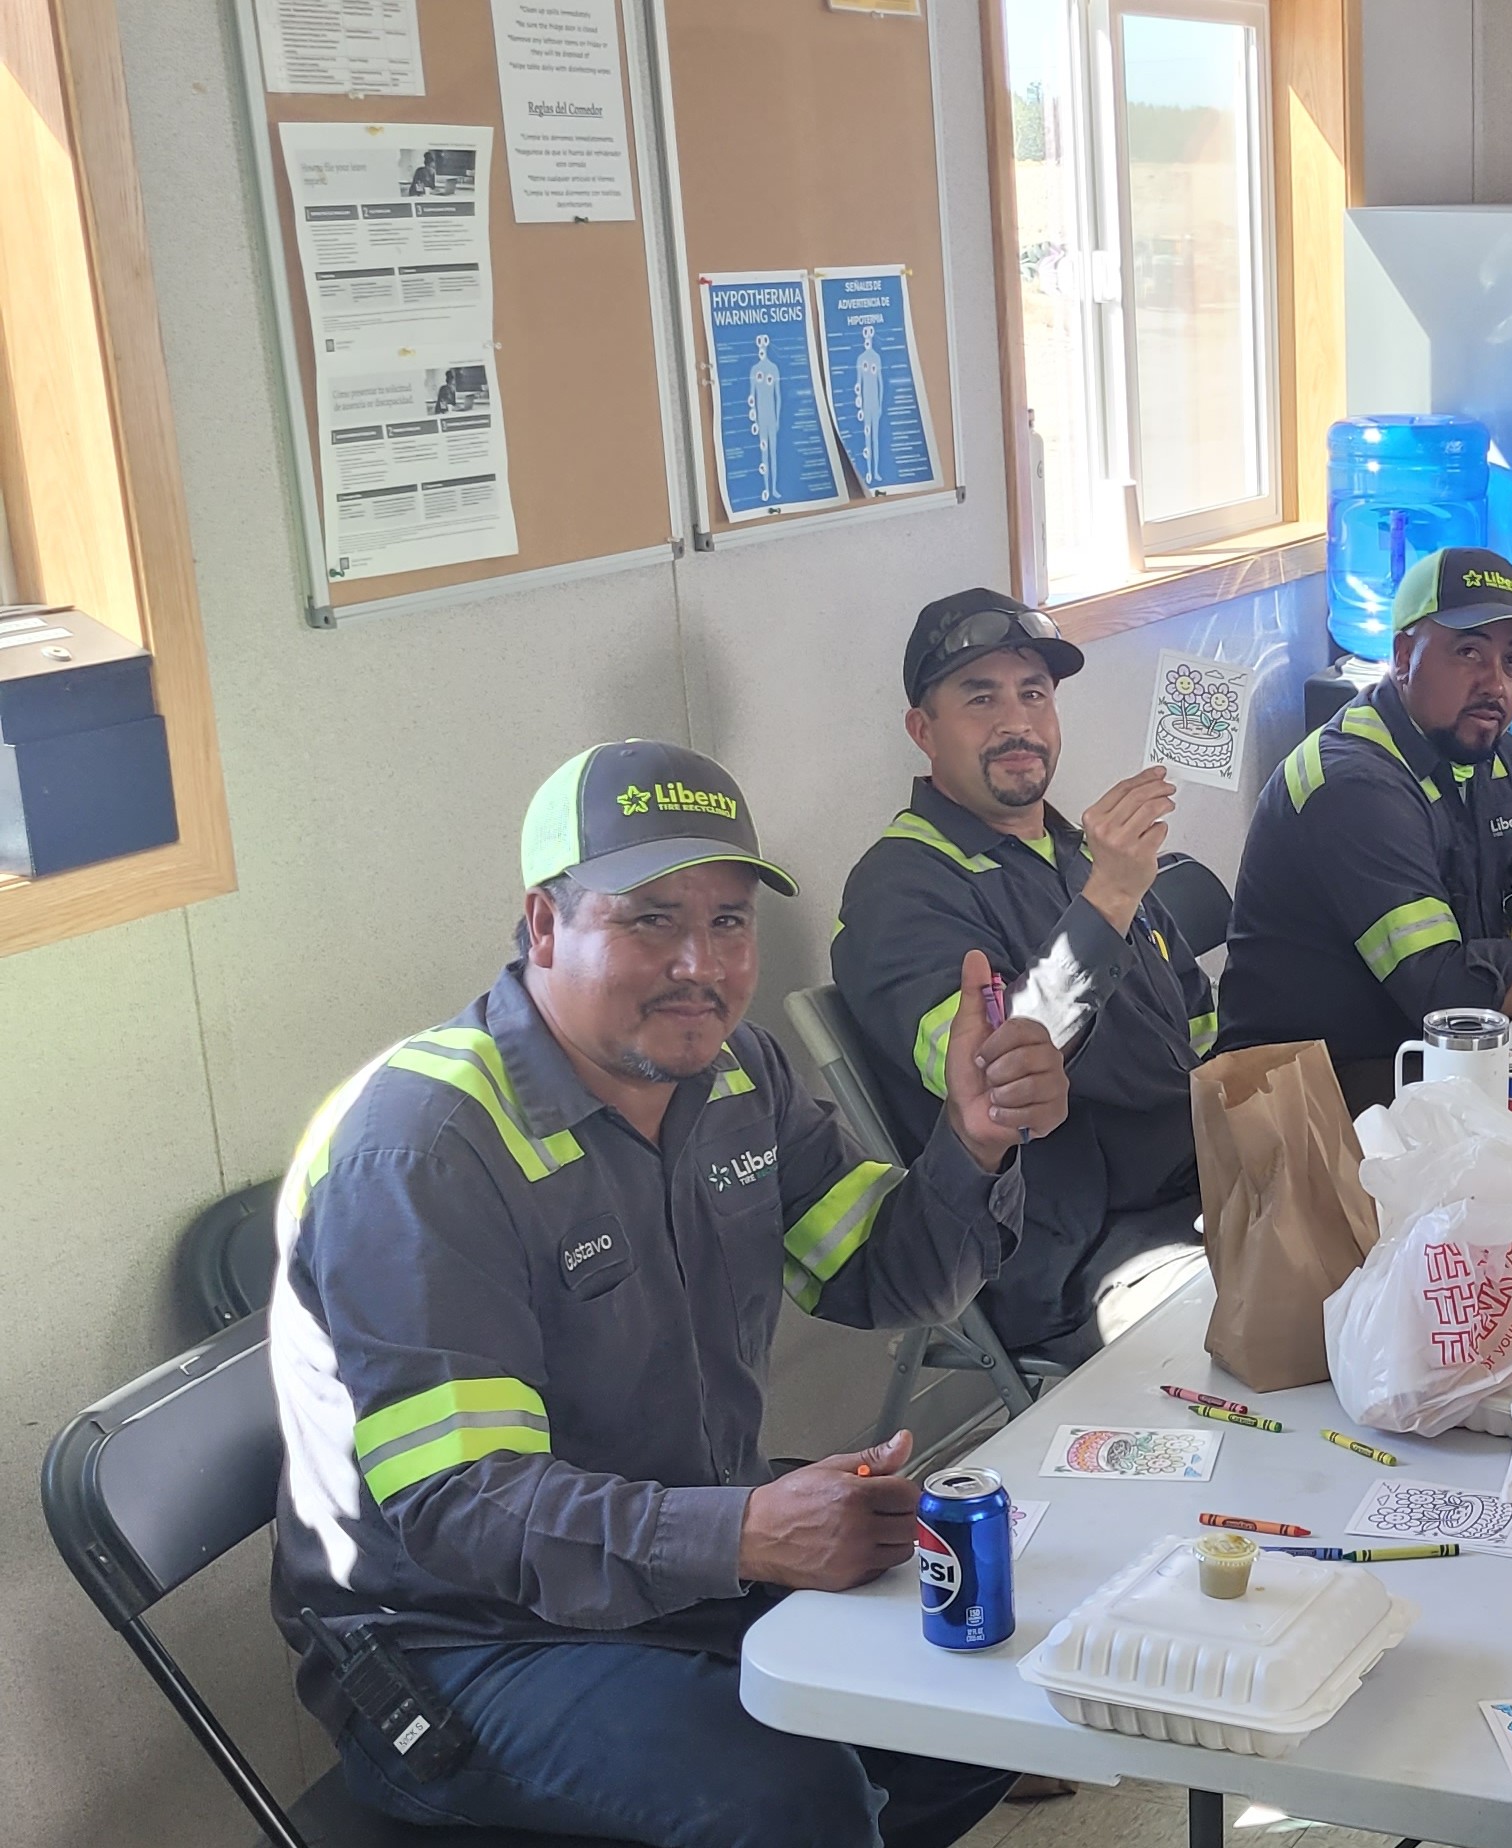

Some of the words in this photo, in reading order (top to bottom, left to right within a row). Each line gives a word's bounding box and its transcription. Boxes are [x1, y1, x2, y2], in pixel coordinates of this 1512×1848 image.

[528, 101, 553, 117] Reglas
[555, 101, 567, 115] del
[568, 103, 603, 117] Comedor
[844, 280, 873, 292] SEÑALES
[874, 280, 882, 290] DE
[713, 287, 803, 308] HYPOTHERMIA
[837, 297, 880, 310] ADVERTENCIA
[881, 296, 890, 307] DE
[714, 309, 768, 326] WARNING
[770, 306, 803, 322] SIGNS
[847, 313, 884, 325] HIPOTERMIA
[654, 782, 737, 819] Liberty
[658, 803, 681, 811] TIRE
[683, 804, 731, 818] RECYCLING
[739, 1173, 757, 1186] TIRE
[564, 1234, 613, 1271] Gustavo
